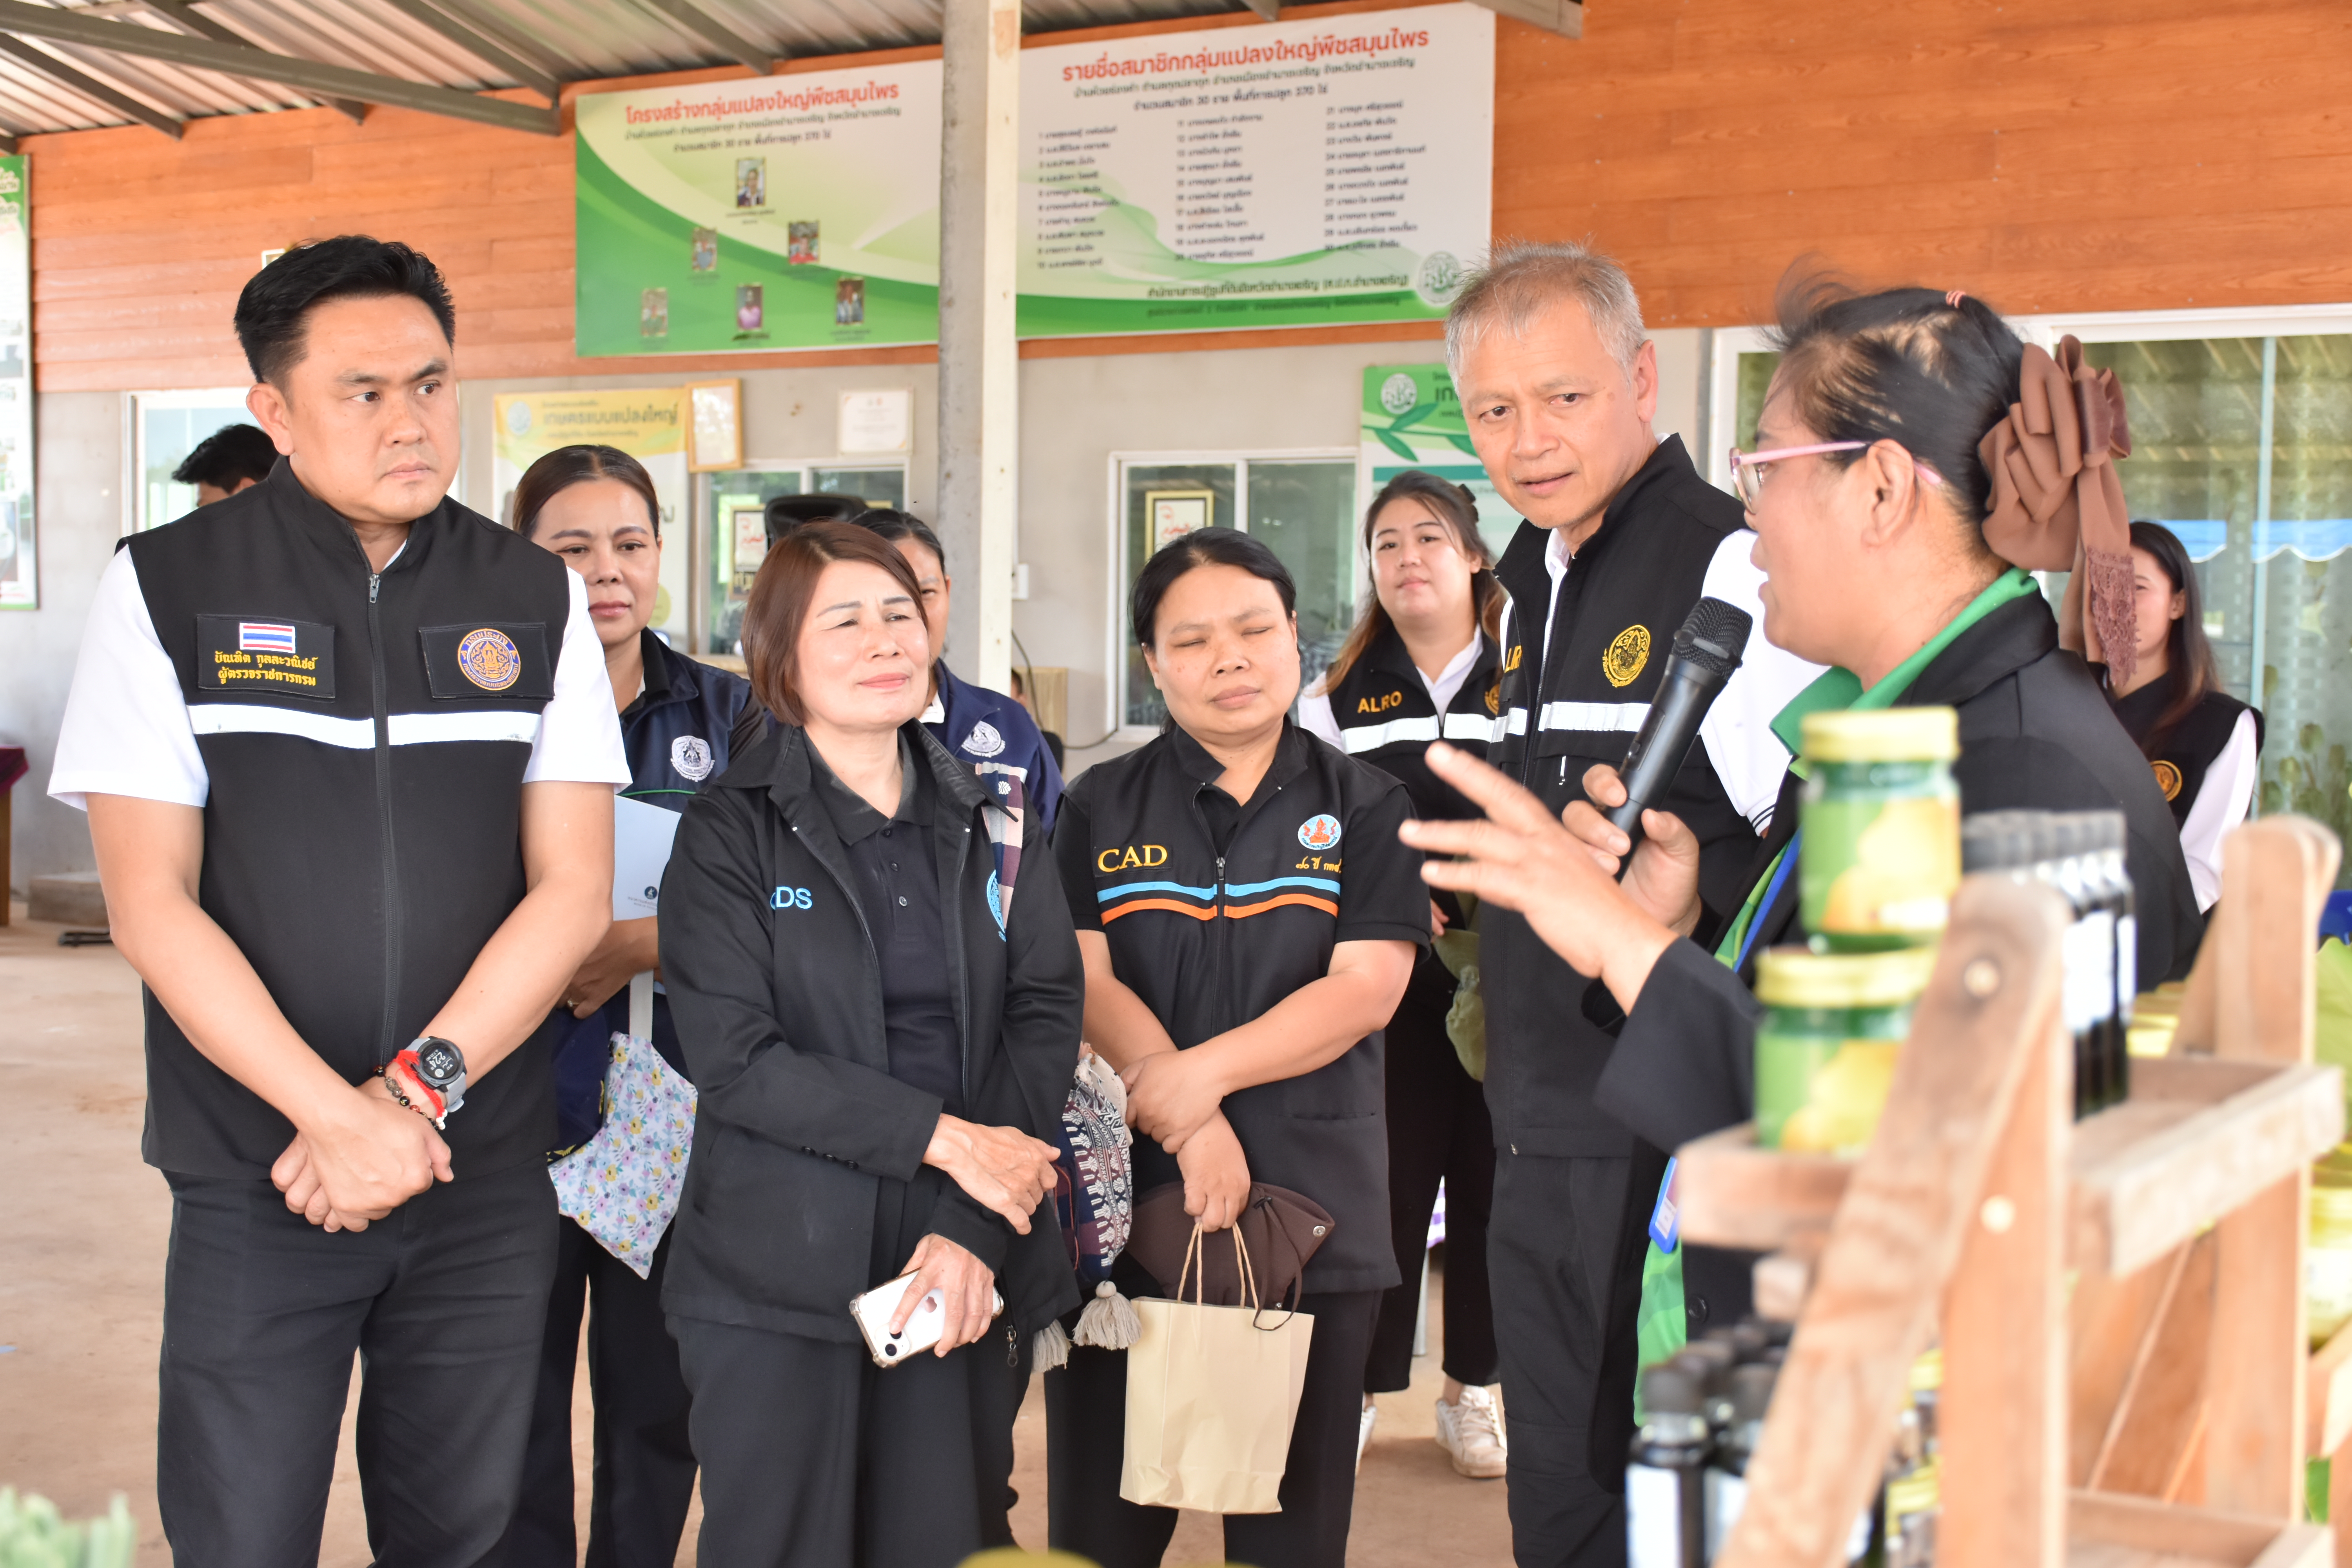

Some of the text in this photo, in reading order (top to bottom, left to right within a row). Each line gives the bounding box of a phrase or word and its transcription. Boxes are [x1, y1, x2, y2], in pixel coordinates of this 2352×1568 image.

[1063, 28, 1429, 81] รายชื่อสมาชิกกลุ่มแปลงใหญ่พืชสมุนไพร
[626, 81, 899, 124] โครงสร้างกลุ่มแปลงใหญ่พืชสมุนไพร
[465, 631, 508, 647] กรมประมง
[215, 651, 318, 670] บัณฑิต กุลละวณิชย์
[218, 666, 316, 686] ผู้ตรวจราชการกรม
[1357, 690, 1403, 714] ALRO
[1098, 845, 1167, 872] CAD
[1311, 856, 1322, 870] ปี
[770, 886, 813, 910] DS
[429, 1051, 446, 1068] 2:24
